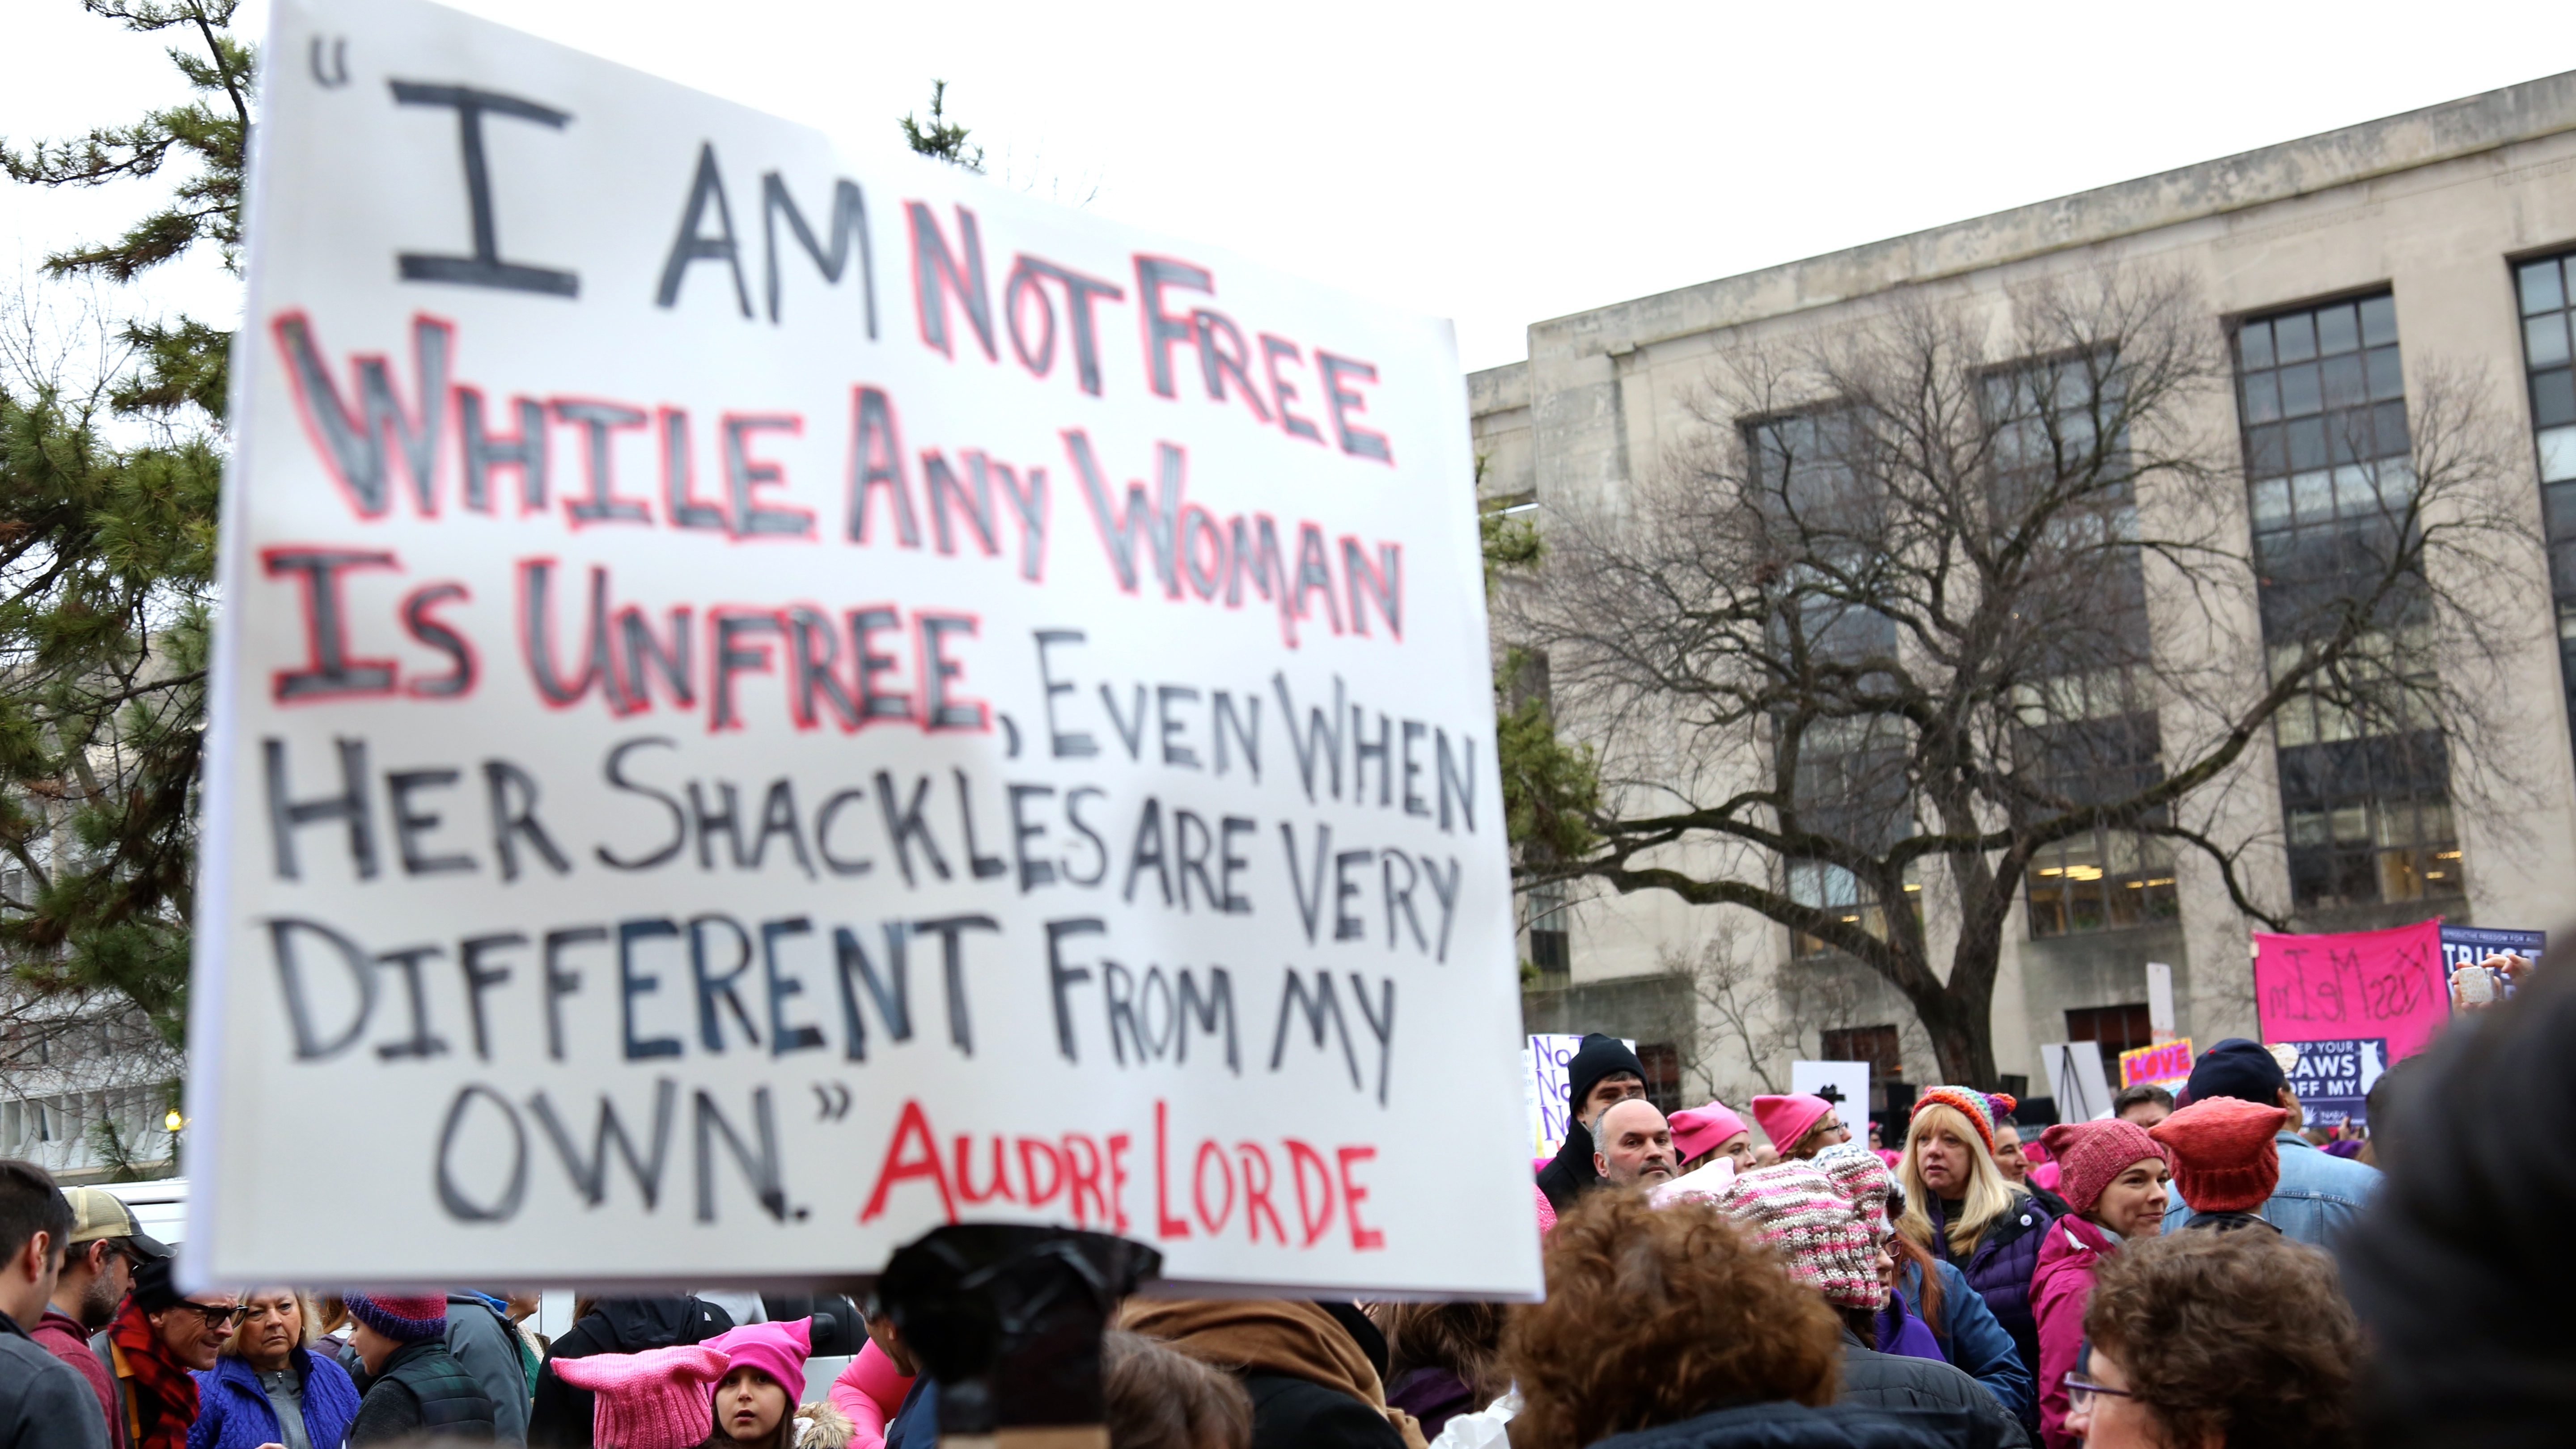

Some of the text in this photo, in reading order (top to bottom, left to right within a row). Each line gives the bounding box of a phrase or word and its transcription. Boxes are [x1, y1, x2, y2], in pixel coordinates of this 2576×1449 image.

[653, 138, 878, 341] AM
[901, 199, 1125, 397] NOT
[1131, 250, 1396, 468] FREE
[270, 306, 1402, 650] WHILE ANY WOMAN
[258, 544, 483, 705] IS
[1032, 629, 1260, 785] EVEN
[1271, 671, 1476, 833] WHEN
[261, 734, 1462, 964] HER SHACKLES ARE VERY
[253, 911, 1000, 1064] DIFFERENT
[1045, 918, 1240, 1078] FROM
[1269, 966, 1394, 1110] MY
[2129, 1047, 2190, 1081] LOVE
[2285, 1054, 2356, 1078] AWS
[2316, 1041, 2354, 1054] YOUR
[2327, 1080, 2356, 1095] MY
[857, 1098, 1131, 1233] AUDRE
[1155, 1098, 1386, 1250] LORDE
